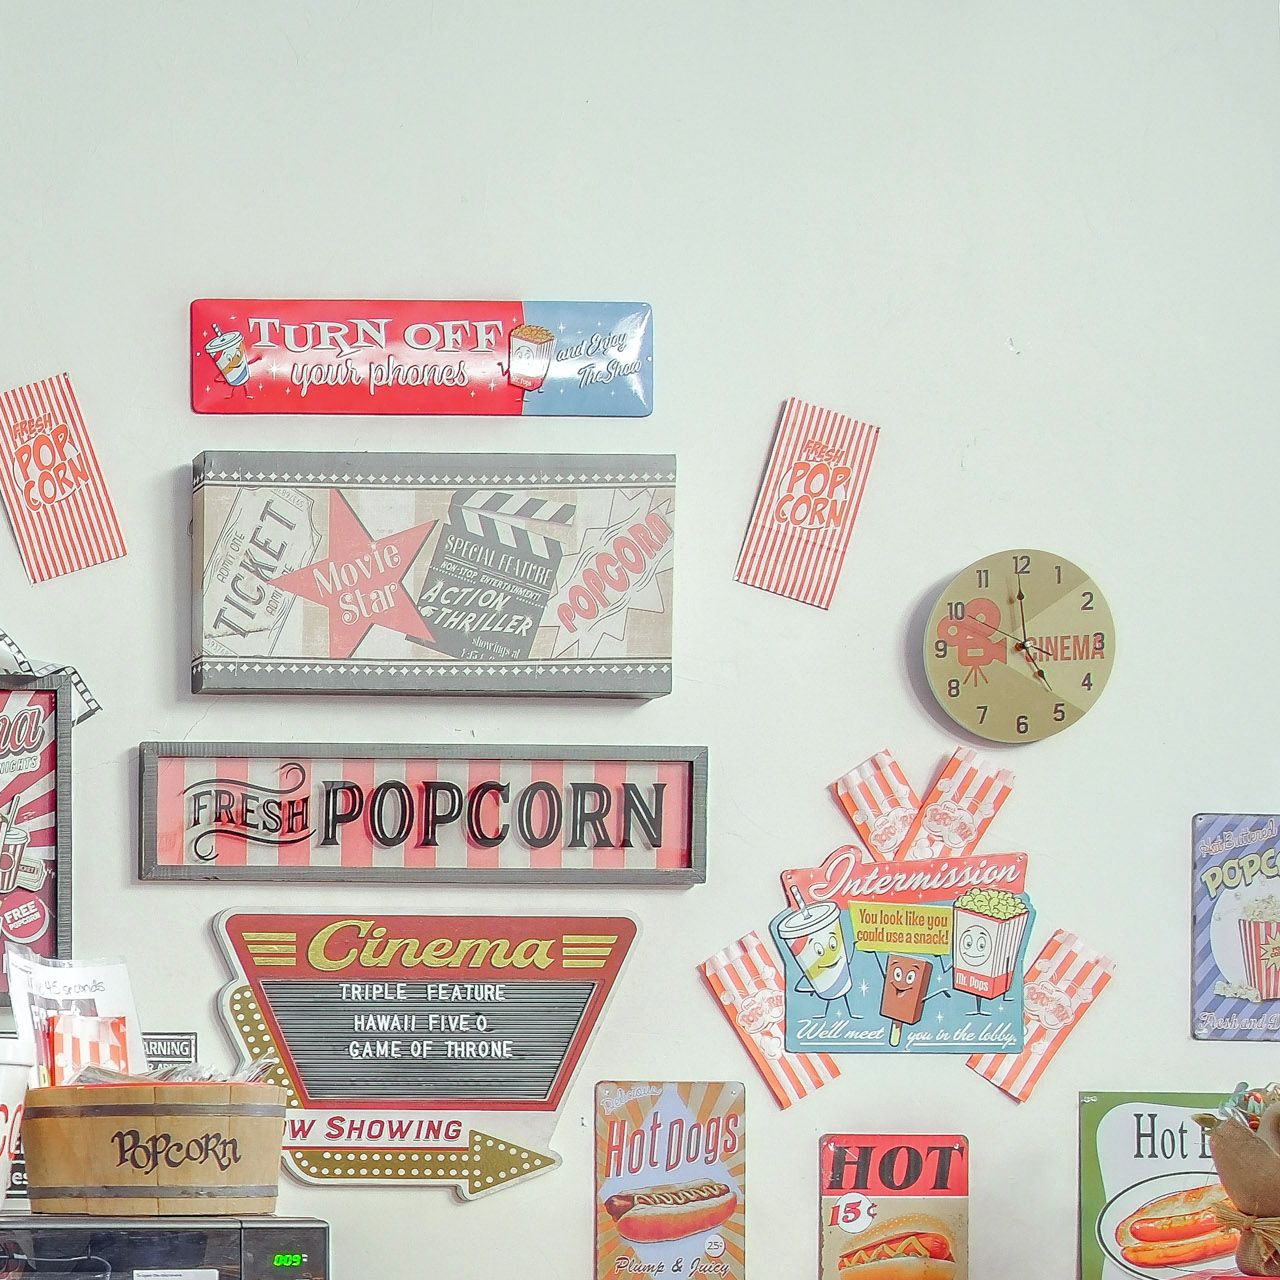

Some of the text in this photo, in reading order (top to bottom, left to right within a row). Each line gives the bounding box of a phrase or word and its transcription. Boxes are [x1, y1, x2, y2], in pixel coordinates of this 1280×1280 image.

[248, 317, 505, 357] TURN OFF
[556, 333, 627, 361] and Enjoy
[291, 358, 468, 396] your phones
[578, 363, 603, 389] The
[13, 412, 53, 441] FRESH
[15, 425, 70, 480] POP
[803, 439, 845, 464] FRESH
[23, 454, 89, 513] CORN
[786, 462, 852, 498] POP
[775, 494, 848, 528] CORN
[213, 499, 296, 638] TICKET
[217, 551, 235, 583] ADMIT
[313, 543, 401, 598] Movie
[440, 561, 478, 579] NON-STOP
[444, 534, 553, 586] SPECIAL FEATURE
[1012, 555, 1031, 575] 12
[556, 513, 674, 634] POPCORN
[975, 570, 989, 588] 11
[1054, 566, 1062, 584] 1
[339, 581, 398, 625] Star
[421, 579, 511, 611] ACTION
[1081, 592, 1094, 611] 2
[434, 607, 533, 637] THRILLER
[947, 601, 965, 621] 10
[934, 640, 948, 659] 9
[1024, 634, 1105, 662] CINEMA
[1093, 632, 1105, 651] 3
[947, 679, 961, 698] 8
[1081, 673, 1093, 691] 4
[976, 706, 988, 724] 7
[1016, 715, 1029, 734] 6
[1053, 703, 1065, 722] 5
[192, 780, 668, 849] FRESH POPCORN
[1199, 819, 1277, 858] Hot Buttered
[808, 853, 1019, 902] Intermission
[1201, 847, 1280, 900] POPC
[4, 900, 38, 924] FREE
[858, 908, 948, 931] You look like you
[306, 919, 556, 972] Cinema
[856, 926, 949, 946] could use a snack!
[63, 979, 106, 995] seconds
[339, 983, 506, 1002] TRIPLE FEATURE
[956, 972, 989, 993] Mr. Pops
[354, 1014, 416, 1033] HAWAII
[428, 1014, 471, 1033] FIVE
[843, 1026, 885, 1041] meet
[1198, 1011, 1238, 1030] Fresh
[1239, 1012, 1267, 1029] and
[142, 1041, 190, 1056] ARNING
[906, 1022, 1017, 1050] you in the lobby.
[349, 1040, 513, 1059] GAME OF THRONE
[600, 1085, 664, 1115] Delicious
[325, 1116, 463, 1141] SHOWING
[1133, 1113, 1188, 1160] Hot
[605, 1111, 739, 1178] Hot Dogs
[826, 1145, 964, 1191] HOT
[614, 1256, 730, 1277] Plump & Juicy
